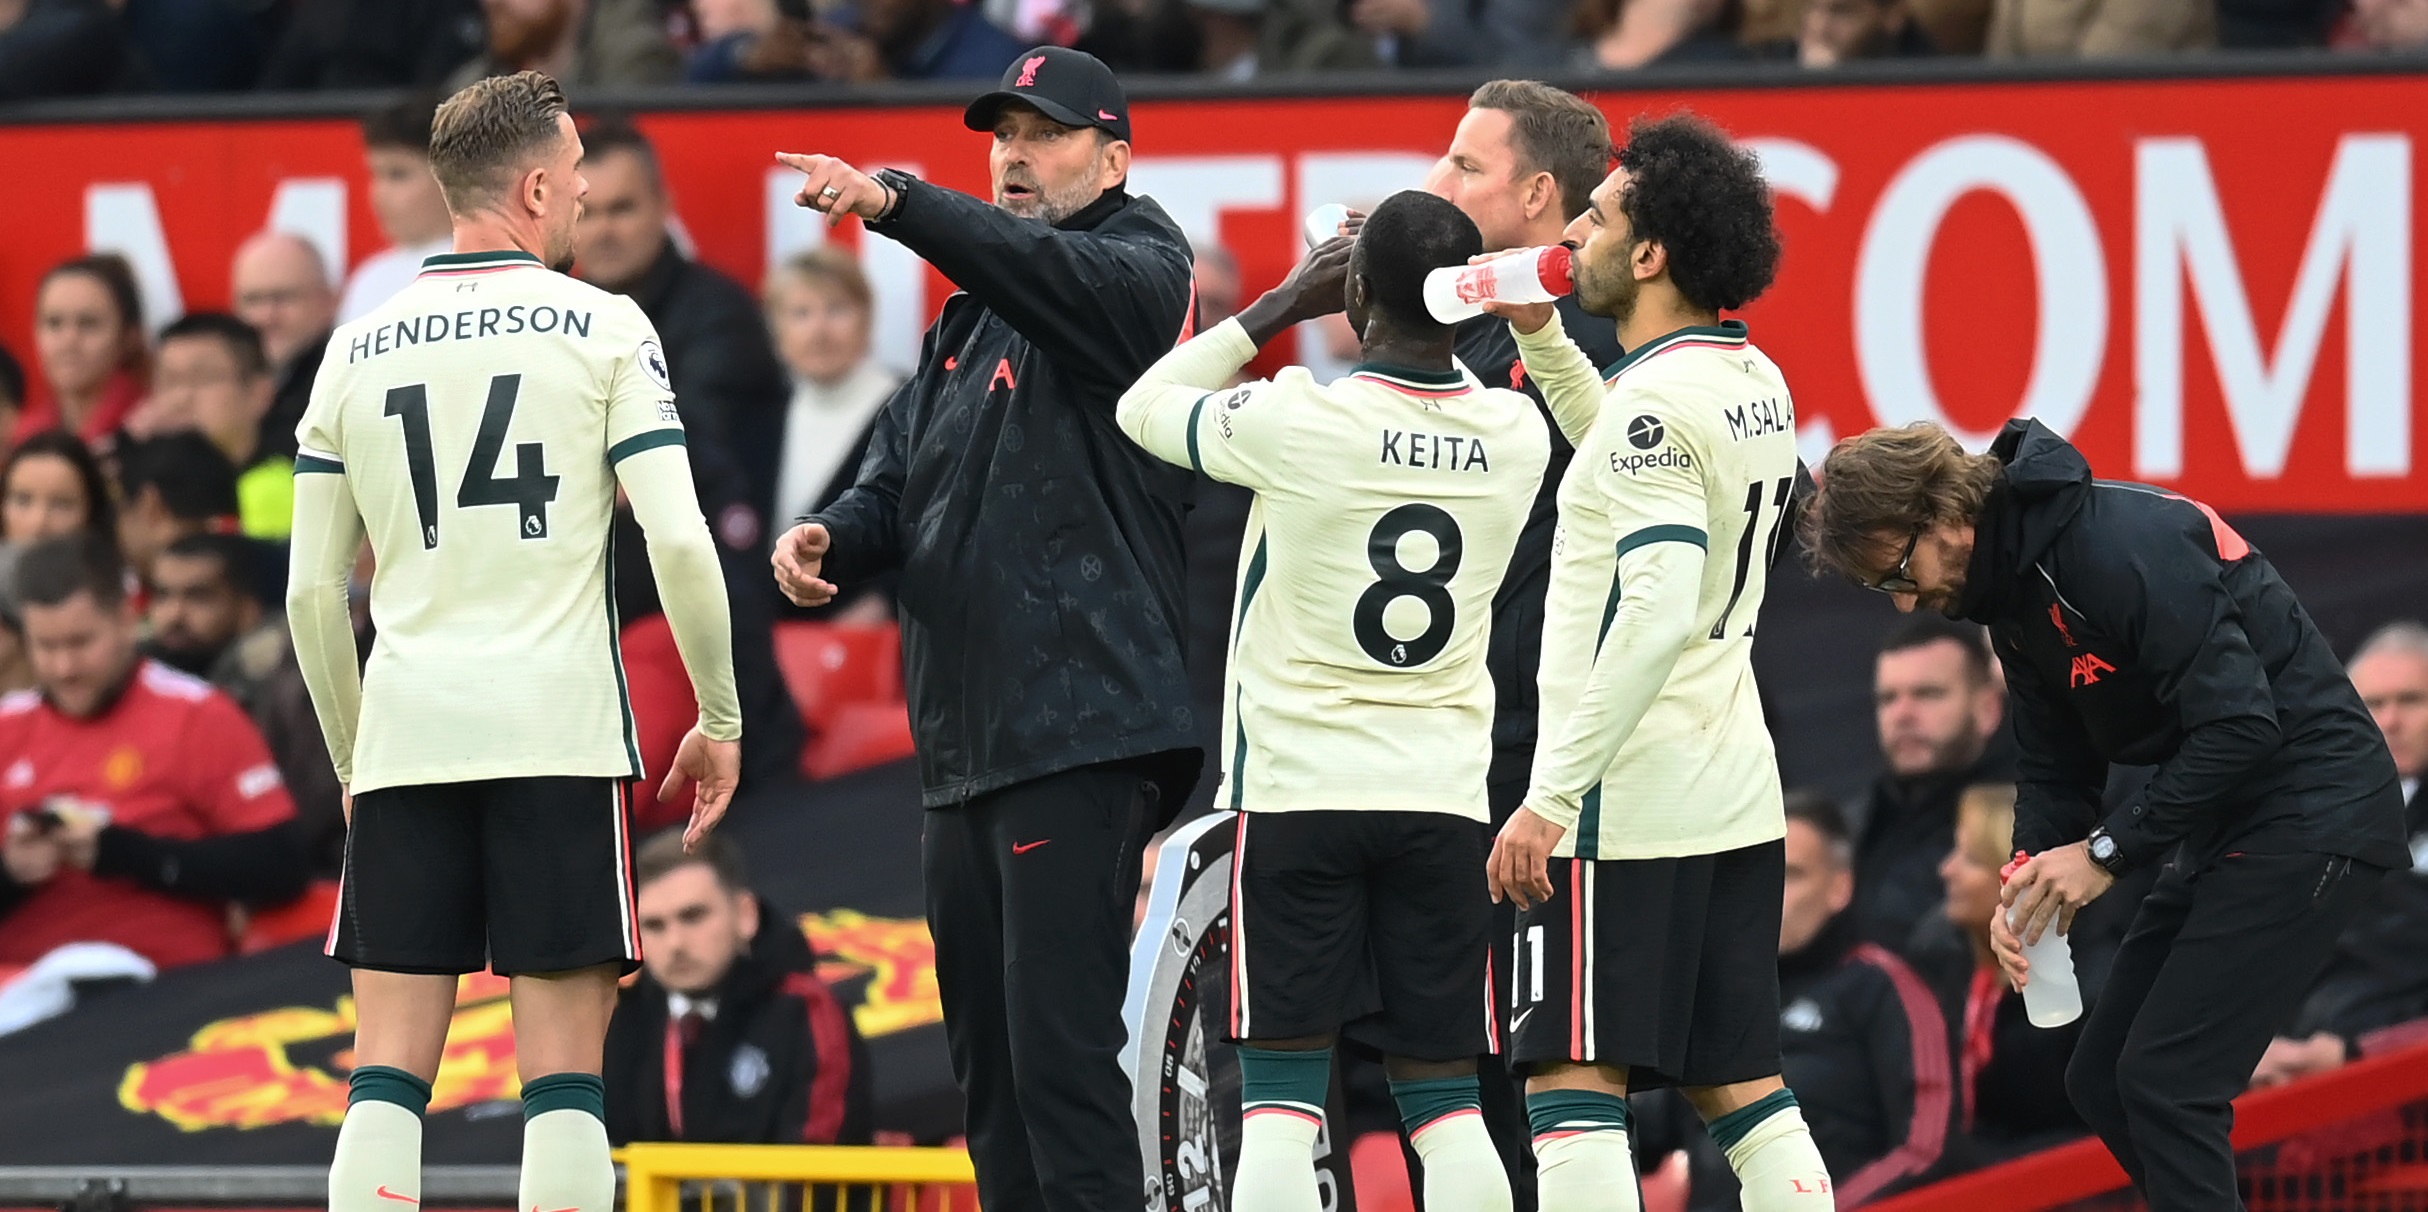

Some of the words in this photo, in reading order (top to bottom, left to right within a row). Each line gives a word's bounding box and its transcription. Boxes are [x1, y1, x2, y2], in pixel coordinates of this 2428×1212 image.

[349, 305, 592, 365] HENDERSON
[383, 373, 561, 550] 14
[1380, 429, 1489, 473] KEITA
[1610, 446, 1691, 476] Expedia
[1352, 502, 1463, 669] 8
[2070, 652, 2117, 689] AXA
